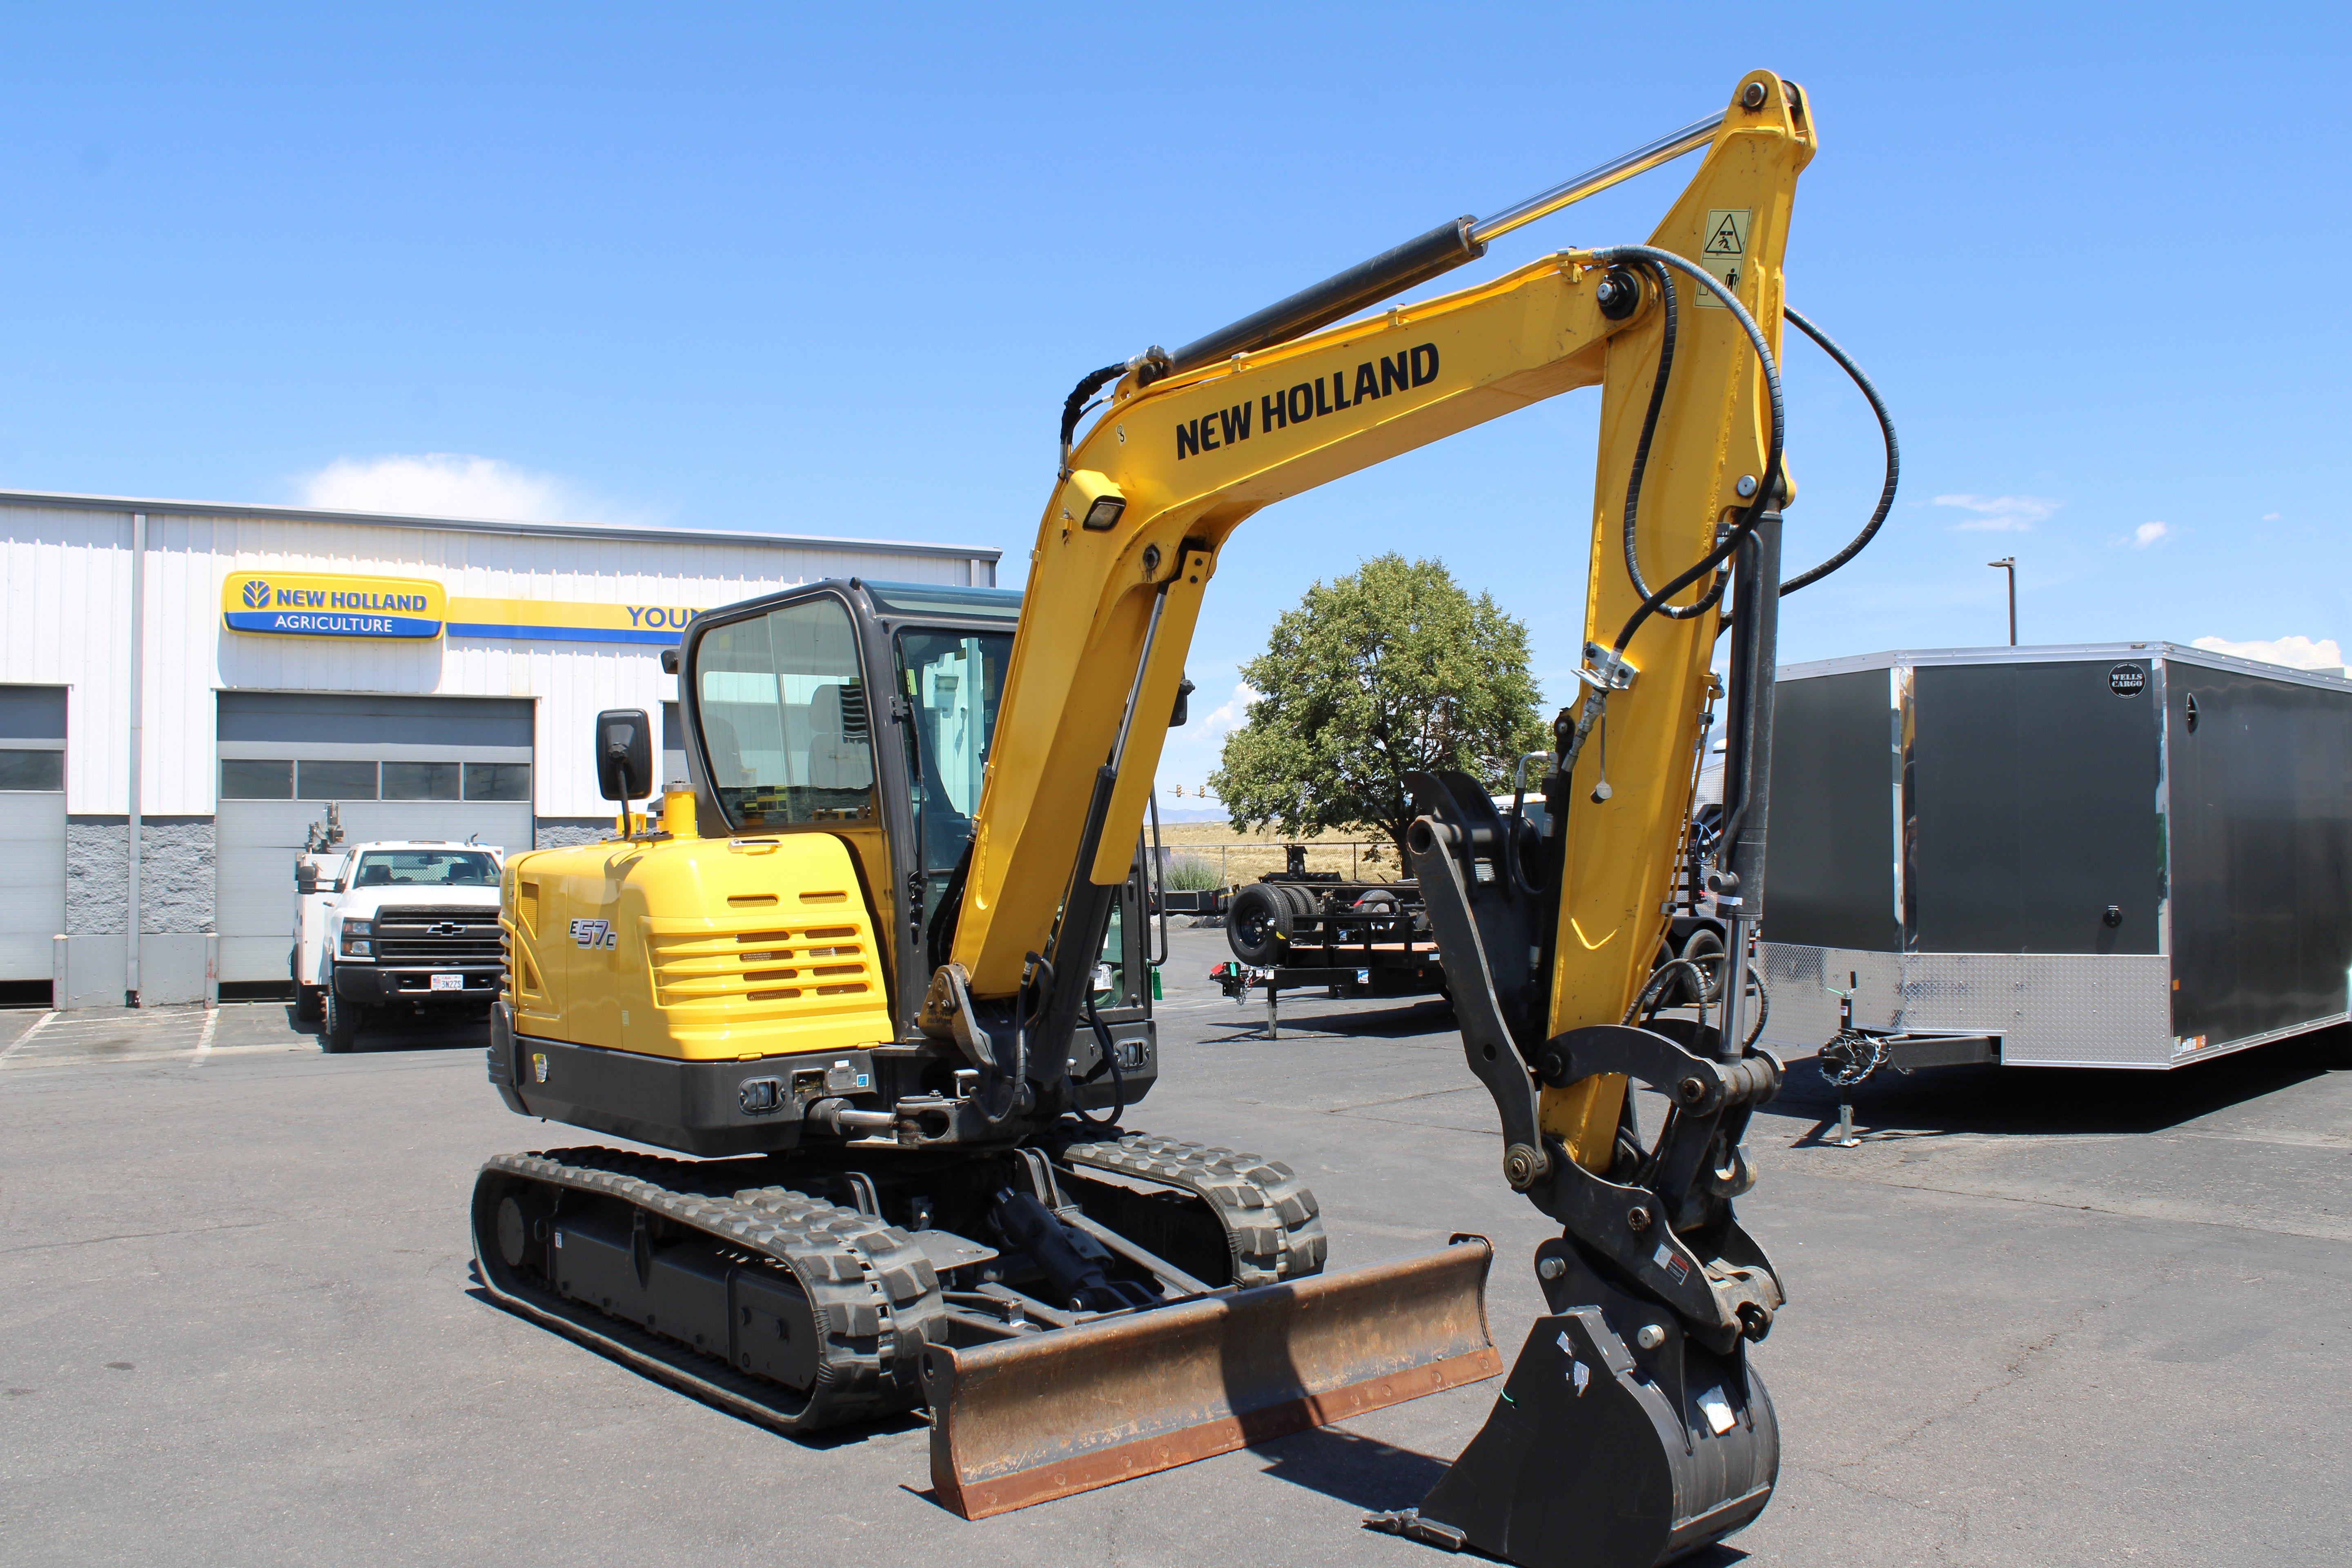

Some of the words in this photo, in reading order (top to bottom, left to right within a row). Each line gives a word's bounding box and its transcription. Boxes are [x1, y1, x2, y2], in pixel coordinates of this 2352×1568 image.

[1176, 400, 1252, 461] NEW
[1261, 342, 1440, 434] HOLLAND
[277, 589, 326, 607] NEW
[331, 591, 428, 611] HOLLAND
[275, 615, 393, 633] AGRICULTURE
[626, 606, 700, 629] YOU
